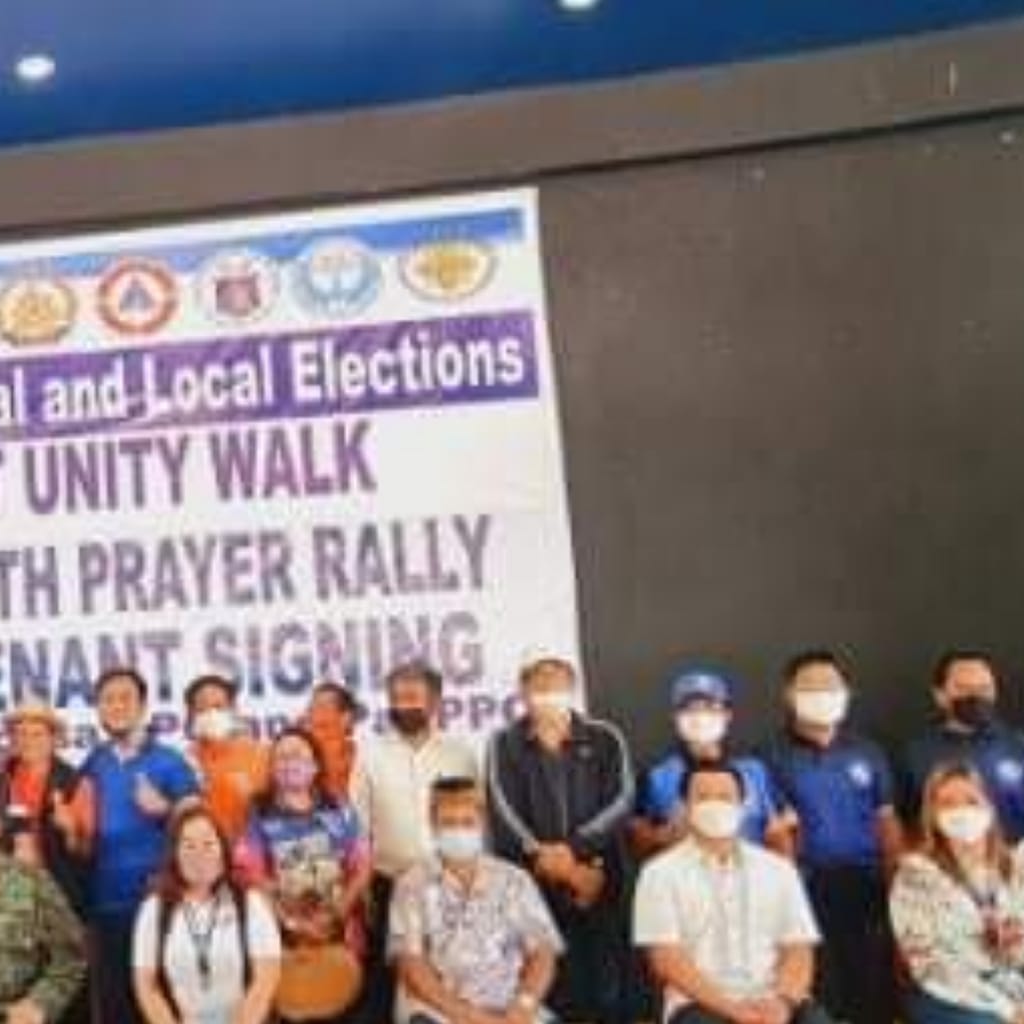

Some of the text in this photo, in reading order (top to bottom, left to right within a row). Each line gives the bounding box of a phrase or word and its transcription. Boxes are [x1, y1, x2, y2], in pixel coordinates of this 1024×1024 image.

[42, 359, 125, 420] and
[144, 343, 274, 415] Local
[291, 328, 525, 398] Elections
[24, 433, 189, 515] UNITY
[210, 419, 377, 501] WALK
[79, 530, 295, 616] PRAYER
[312, 512, 492, 600] RALLY
[205, 611, 483, 697] SIGNING
